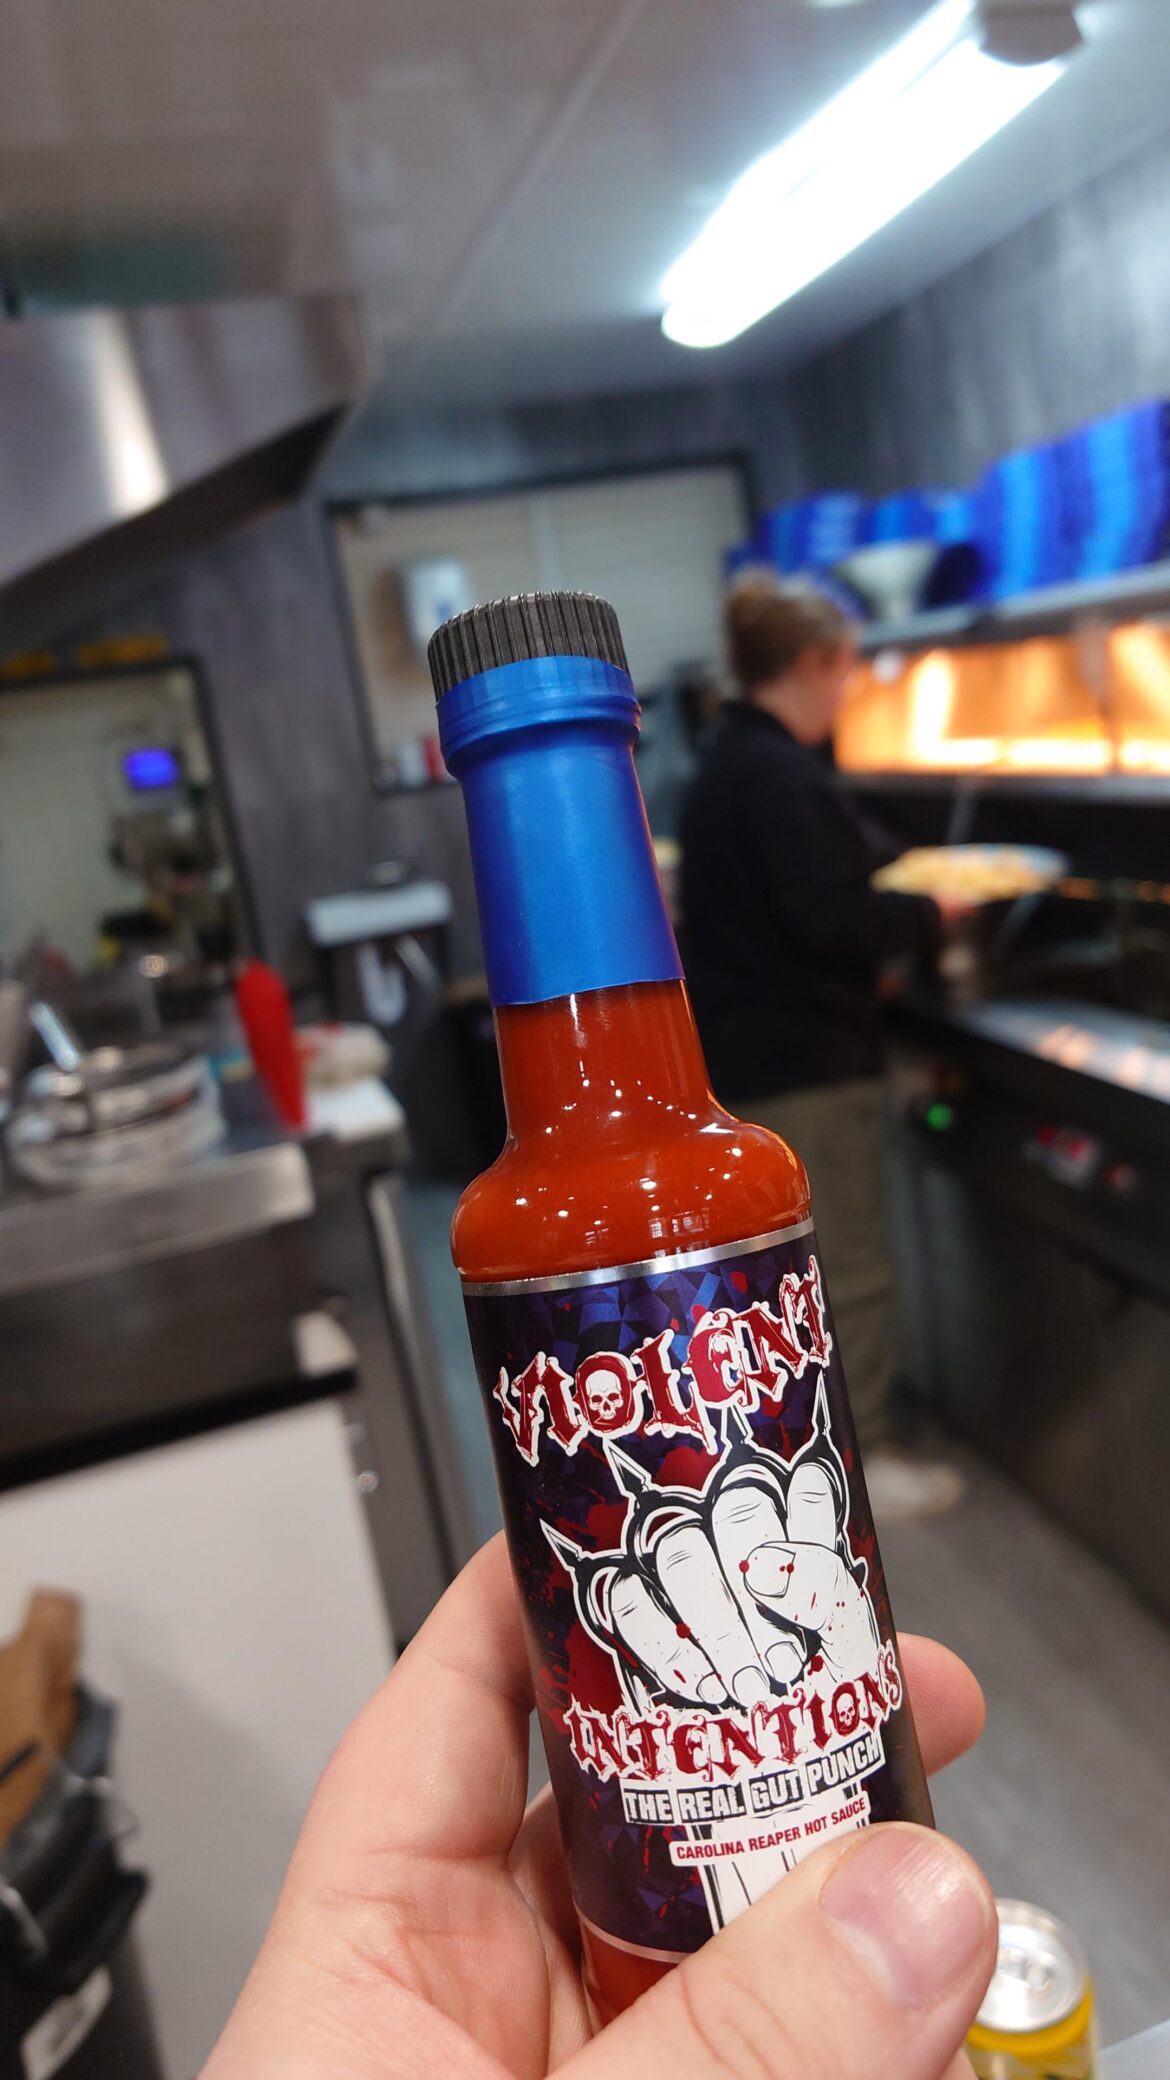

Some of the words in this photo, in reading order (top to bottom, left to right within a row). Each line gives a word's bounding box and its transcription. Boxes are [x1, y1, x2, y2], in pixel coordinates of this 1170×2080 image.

[495, 1256, 832, 1466] VIOLENT
[564, 1641, 901, 1782] INTENTIONS
[624, 1790, 674, 1822] THE
[677, 1785, 747, 1823] REAL
[751, 1771, 801, 1809] GUT
[808, 1736, 881, 1795] PUNCH
[676, 1841, 745, 1860] CAROLINA
[749, 1827, 801, 1852] REAPER
[804, 1816, 828, 1836] HOT
[831, 1797, 866, 1825] SAUCE
